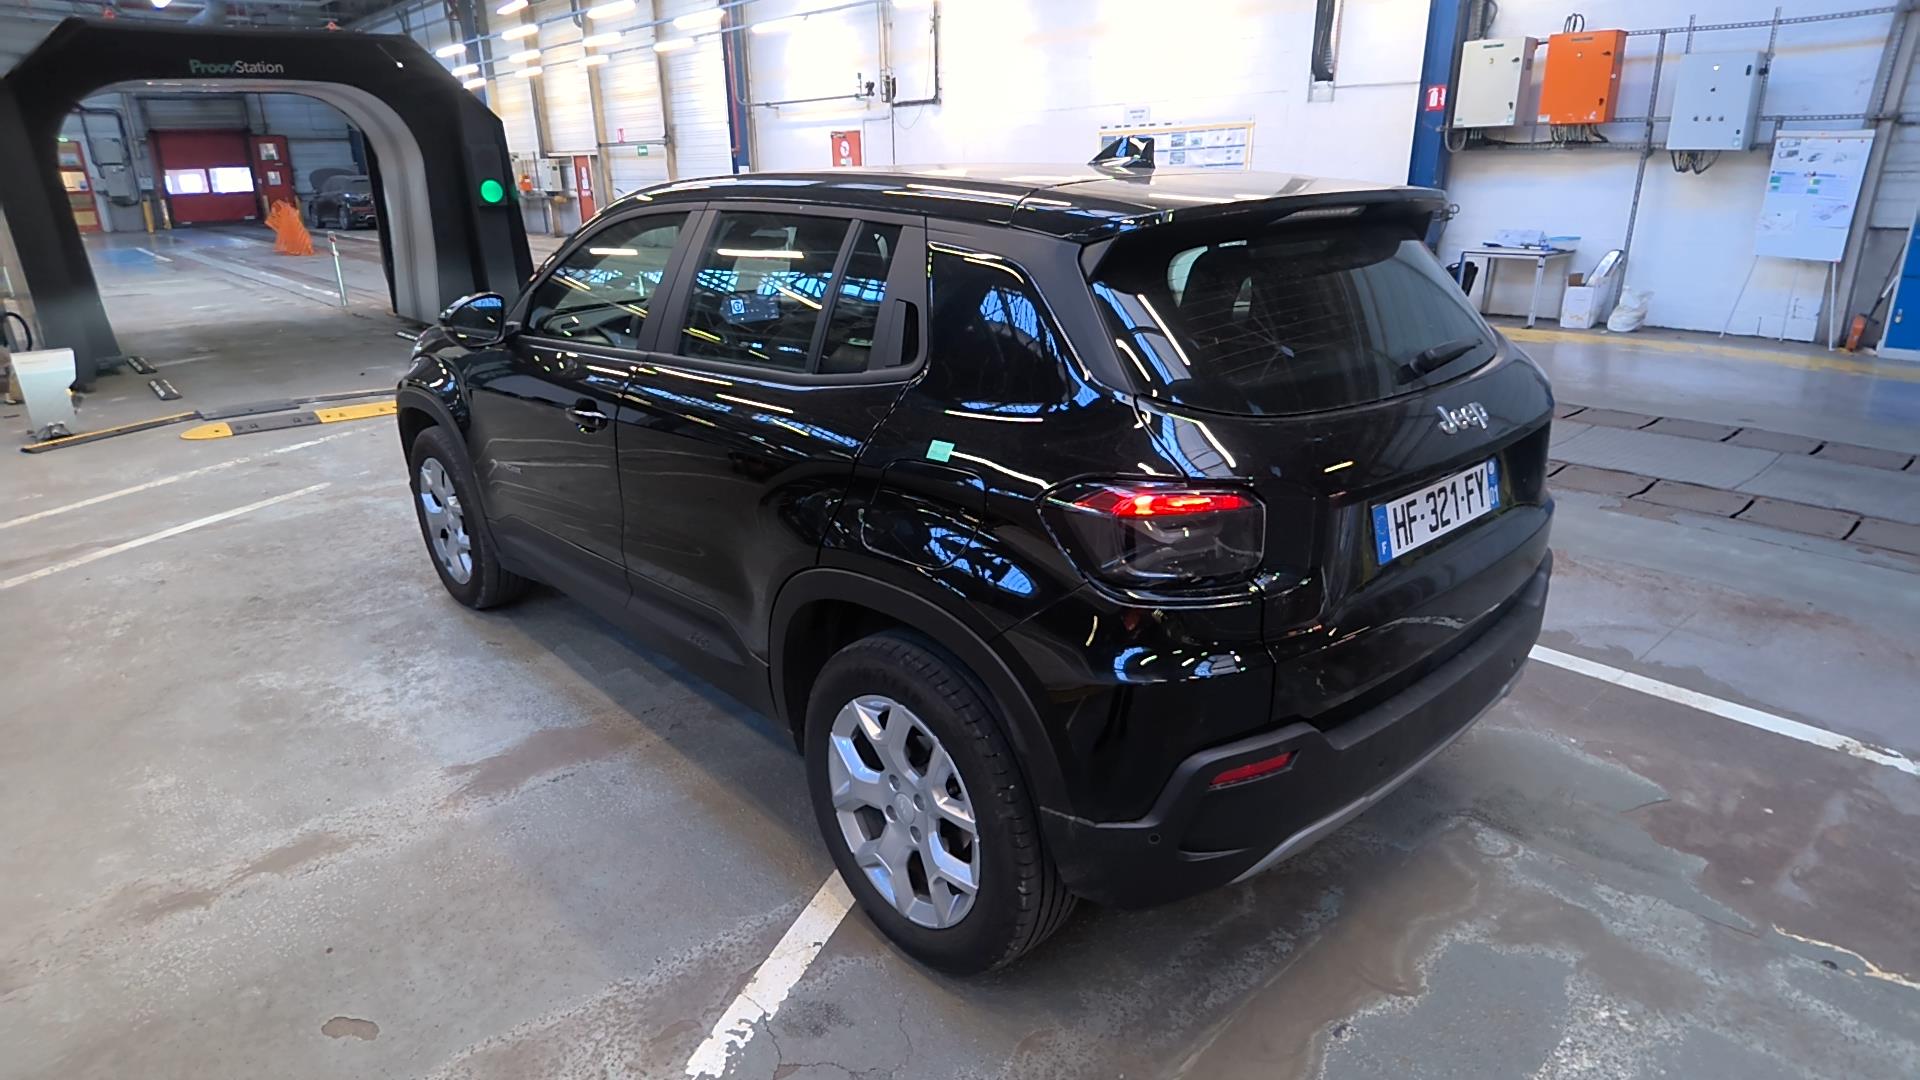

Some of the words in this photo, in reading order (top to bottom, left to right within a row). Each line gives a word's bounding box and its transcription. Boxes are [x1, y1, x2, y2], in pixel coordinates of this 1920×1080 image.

[1437, 402, 1489, 434] Jeep
[1393, 468, 1485, 549] HF-321-FY
[1381, 541, 1388, 555] F
